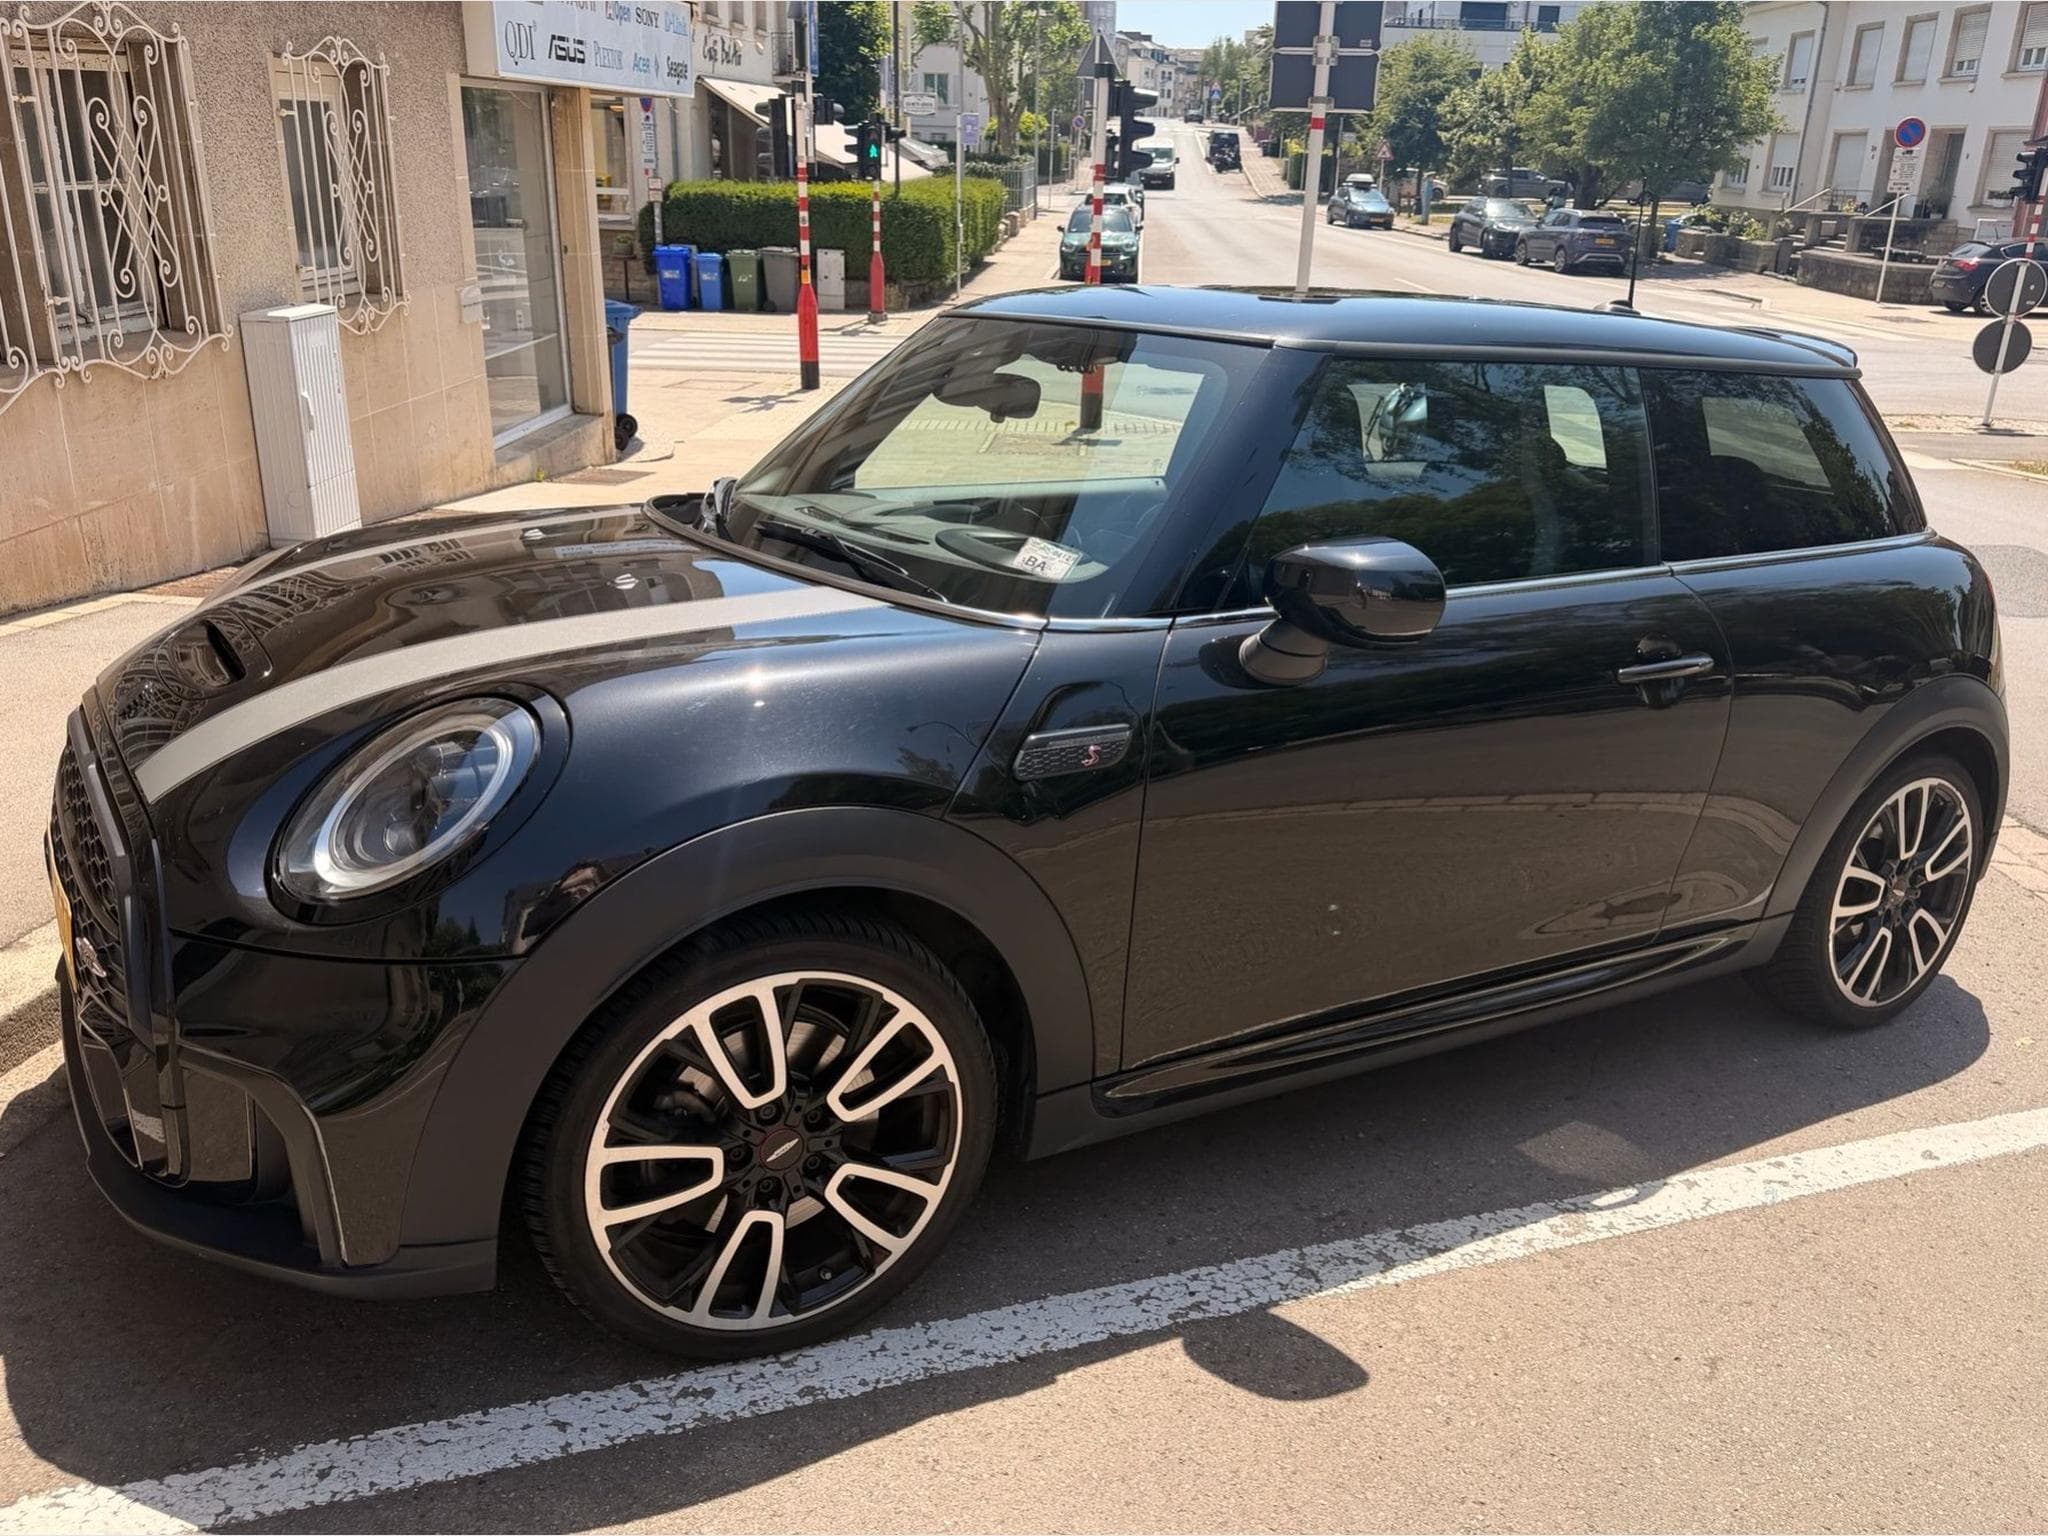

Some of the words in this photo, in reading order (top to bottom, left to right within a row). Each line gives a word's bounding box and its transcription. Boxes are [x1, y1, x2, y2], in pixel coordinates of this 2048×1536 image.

[635, 6, 659, 28] SONY
[504, 20, 535, 66] QDI
[548, 34, 586, 64] ASUS
[667, 55, 688, 85] Seagate
[1025, 555, 1046, 571] BA
[1081, 744, 1102, 768] S
